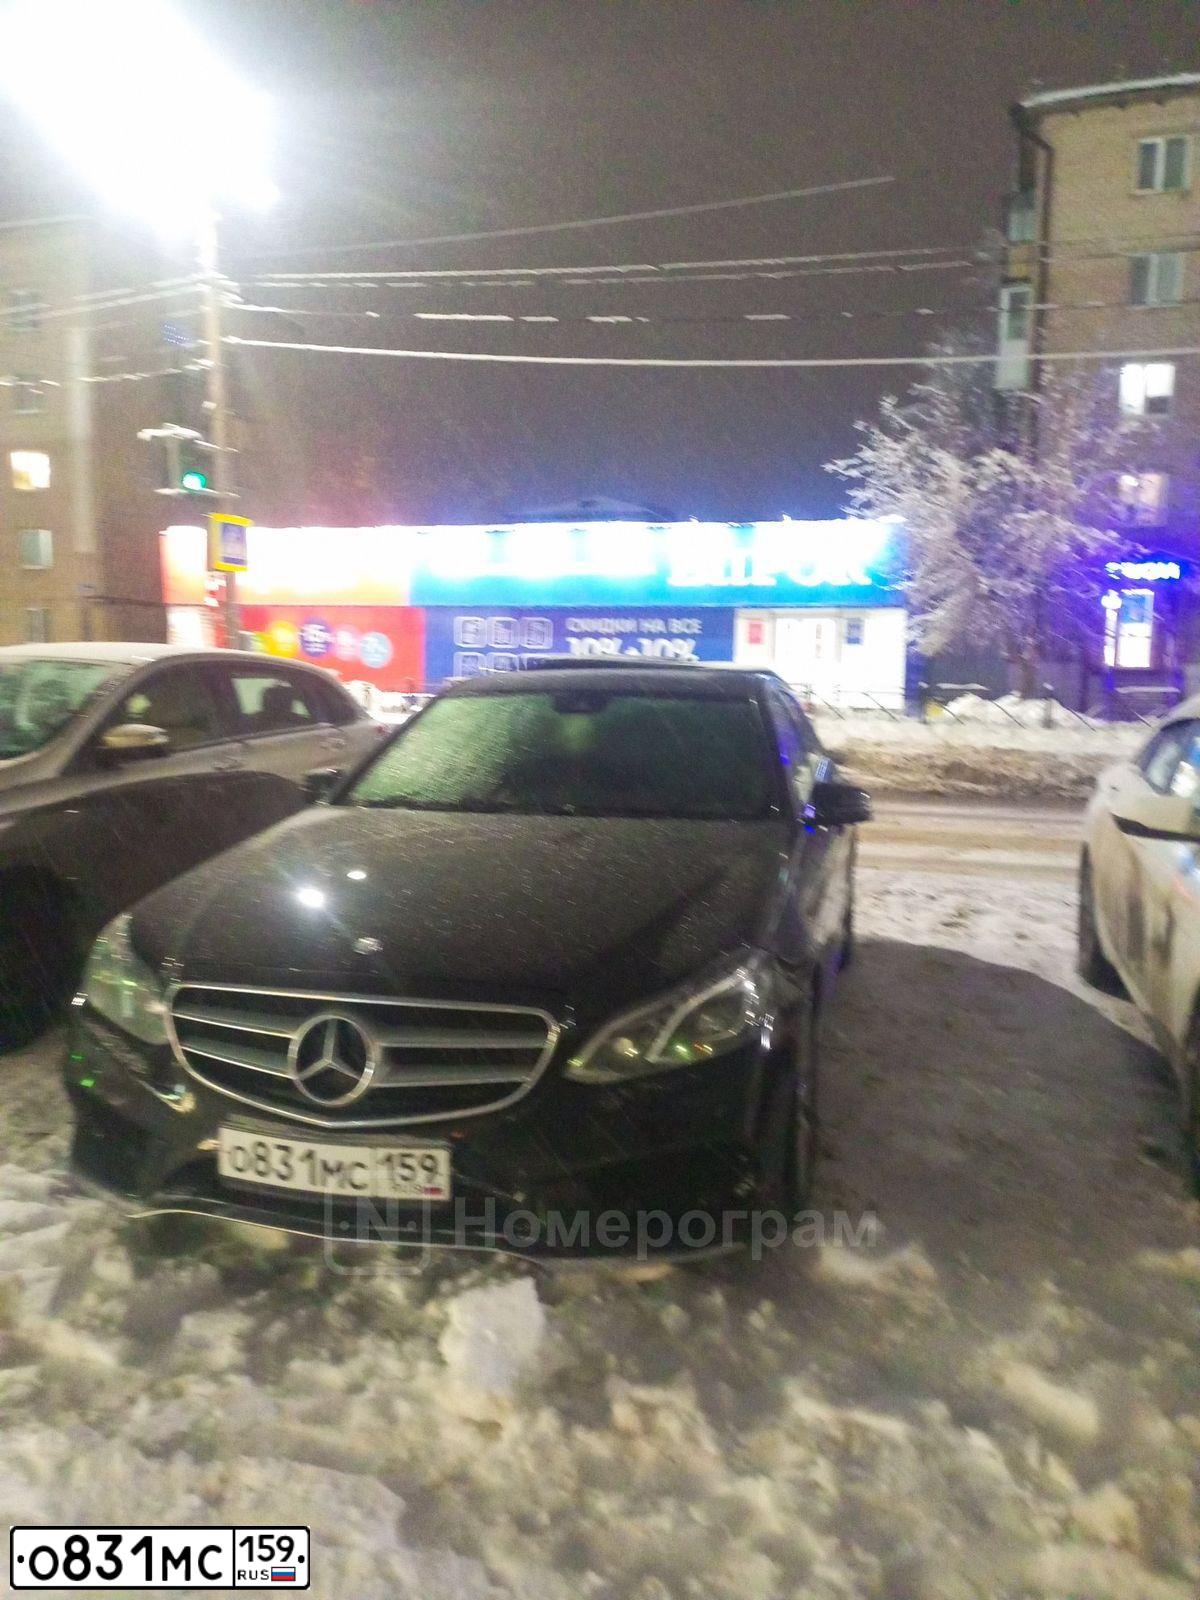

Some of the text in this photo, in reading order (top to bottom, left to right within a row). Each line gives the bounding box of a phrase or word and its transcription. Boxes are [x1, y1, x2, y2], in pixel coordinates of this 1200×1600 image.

[566, 617, 702, 634] СКИДКИ НА ВСЕ
[376, 1152, 438, 1184] 159
